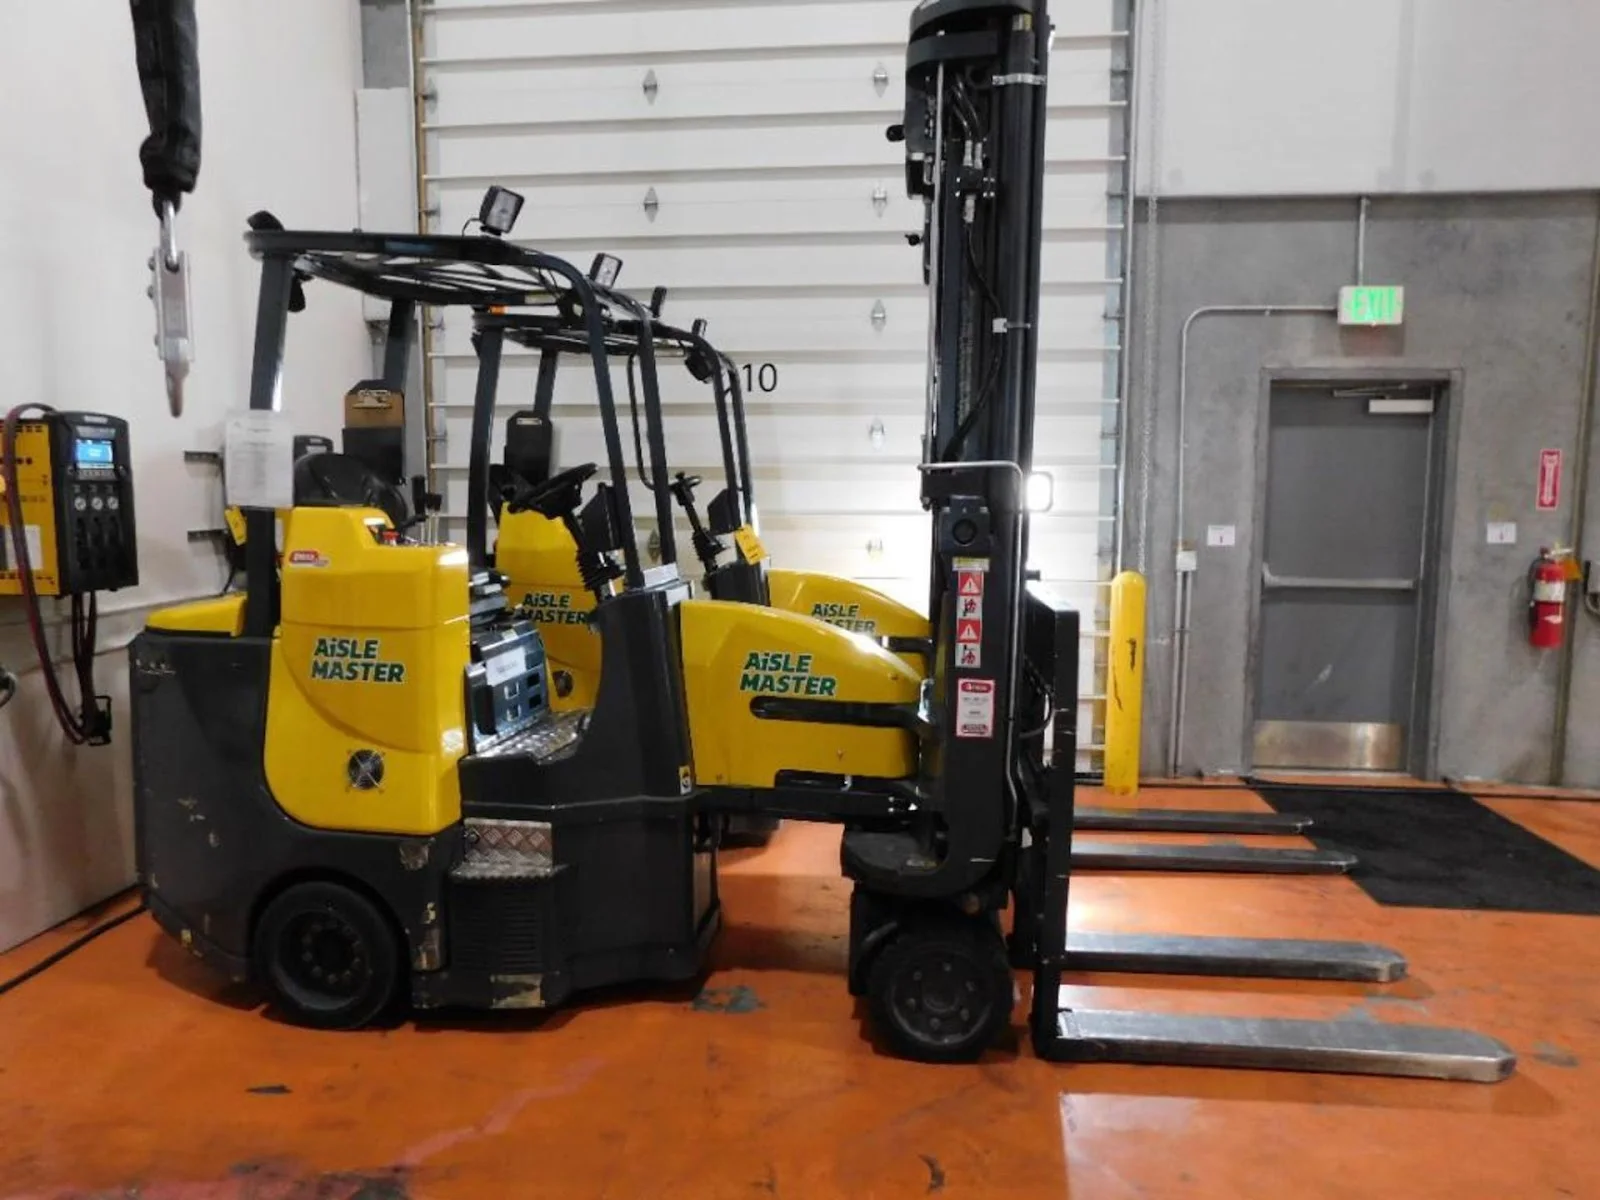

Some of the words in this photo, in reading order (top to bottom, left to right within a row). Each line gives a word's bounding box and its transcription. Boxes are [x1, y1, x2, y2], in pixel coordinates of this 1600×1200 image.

[1351, 287, 1395, 320] EXIT
[742, 363, 777, 392] 10
[311, 659, 405, 682] MASTER
[740, 673, 836, 695] MASTER
